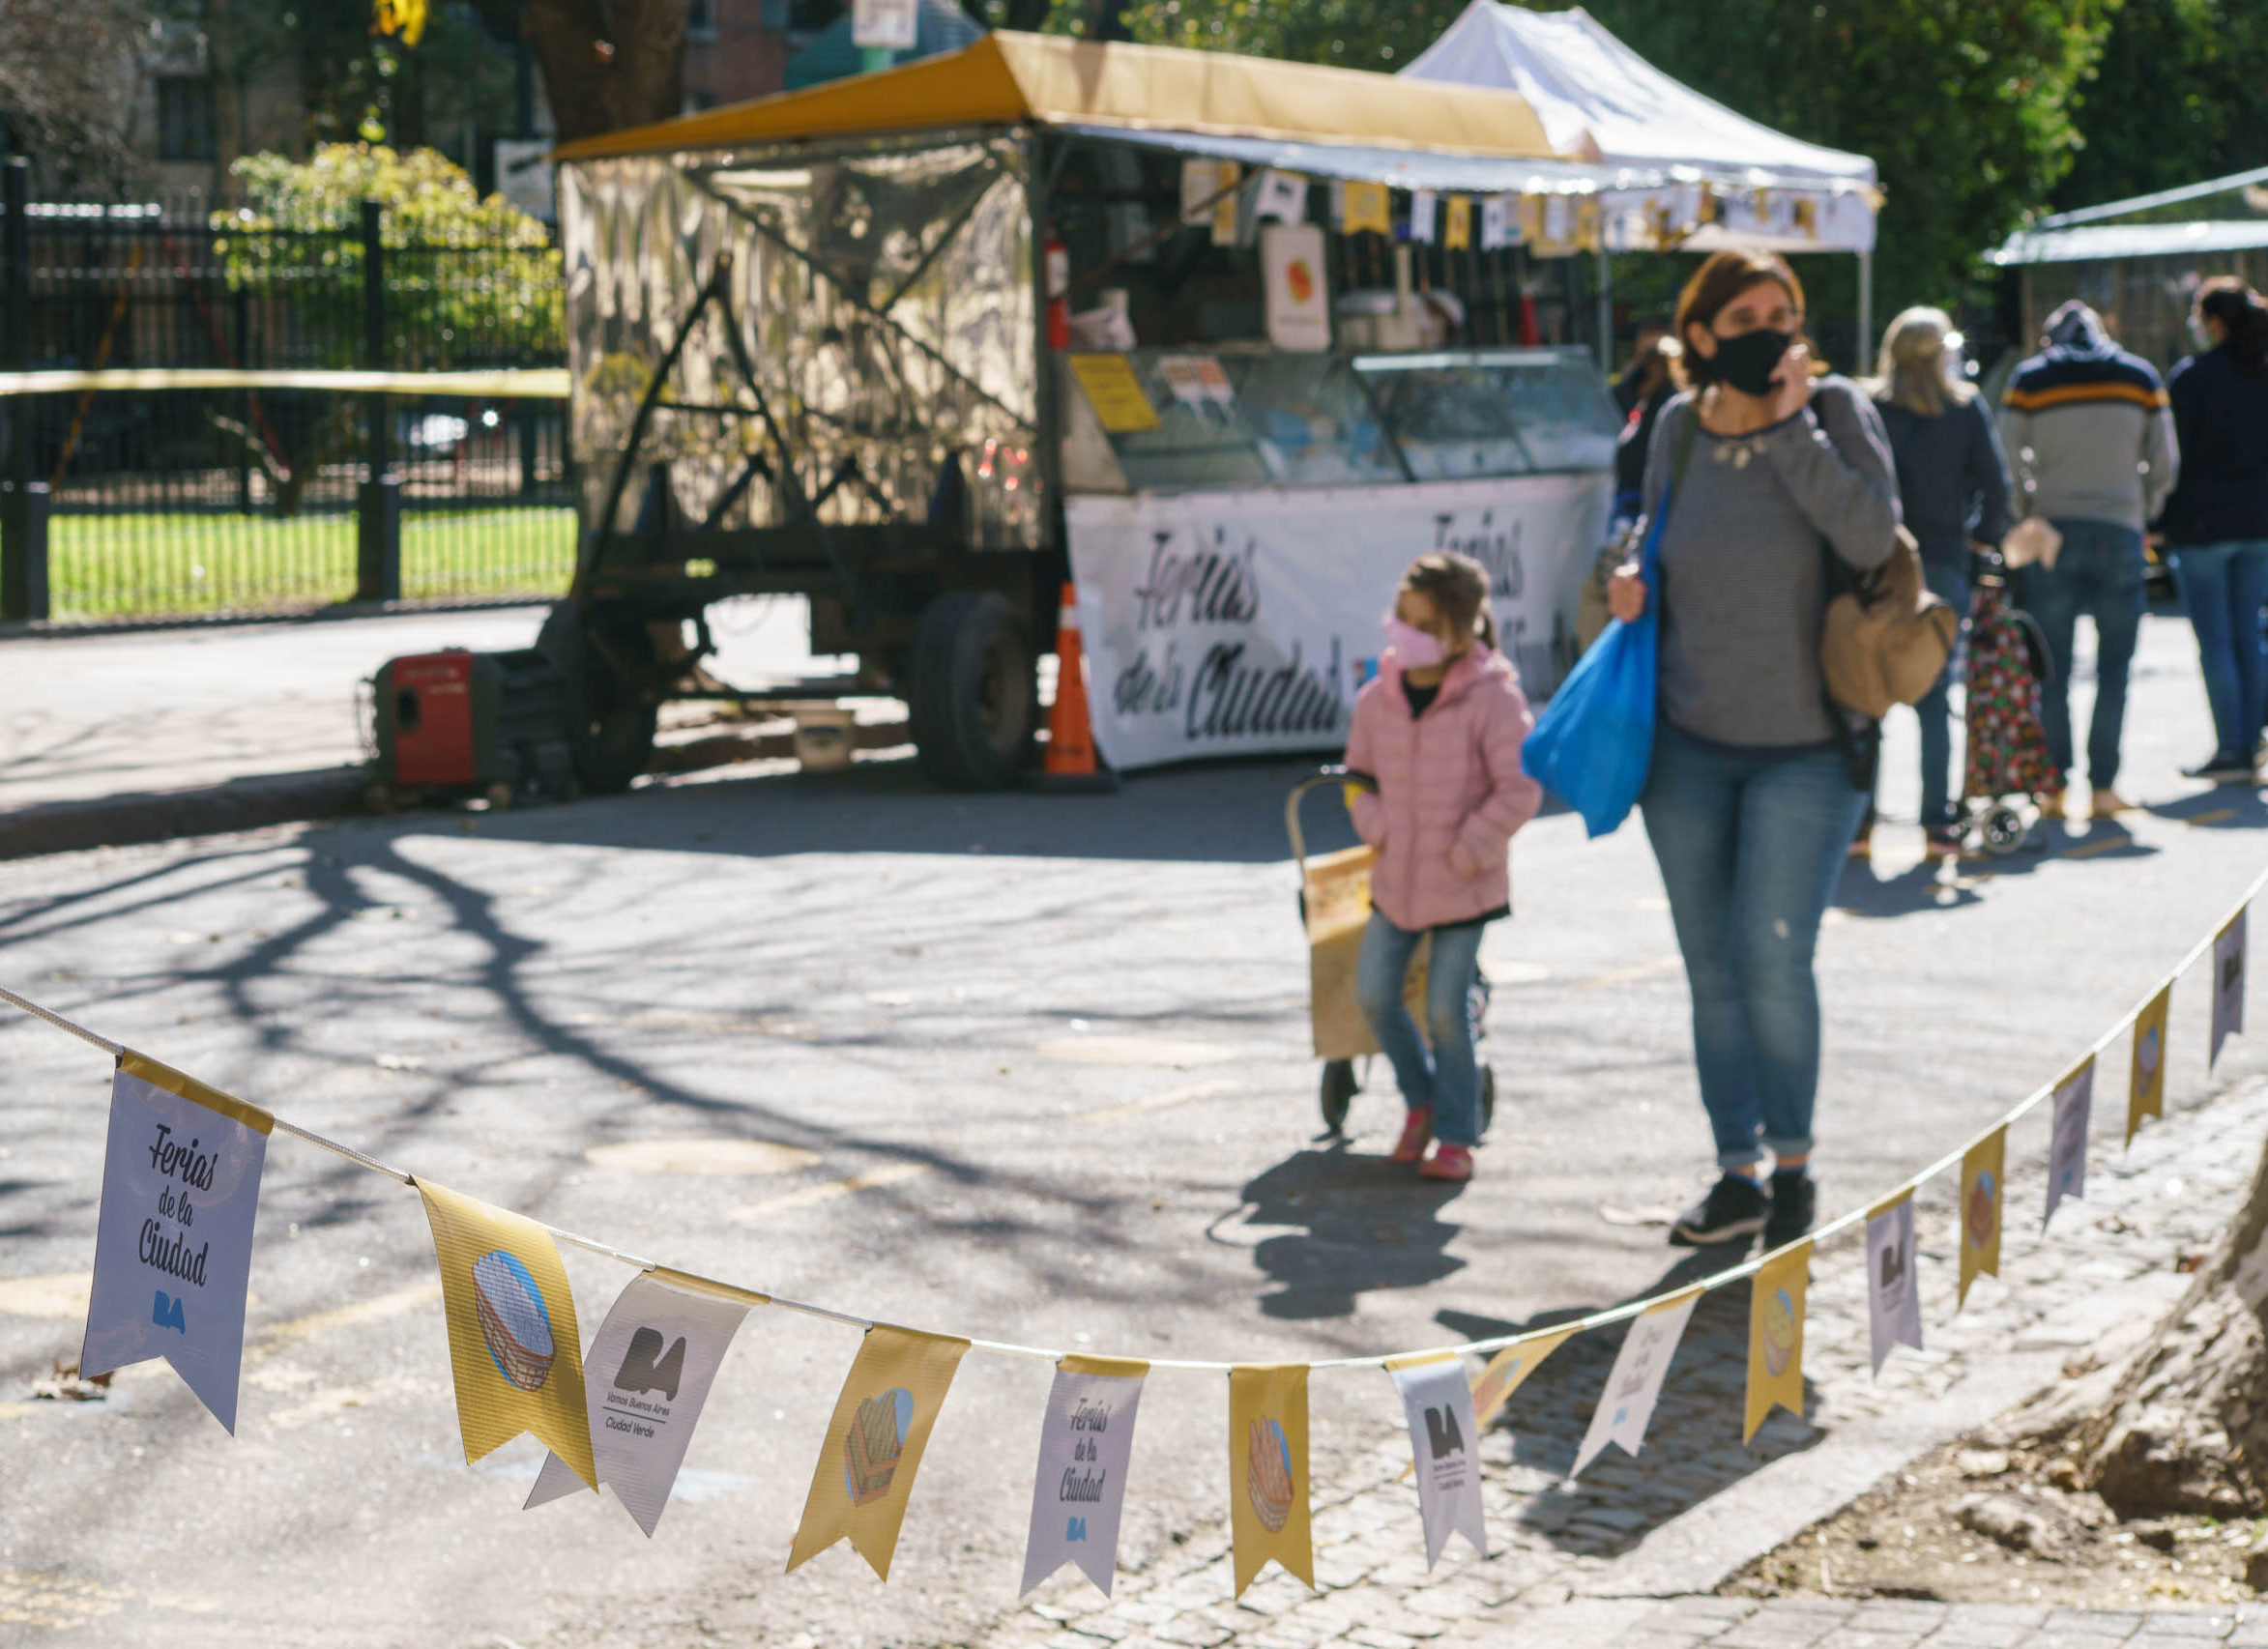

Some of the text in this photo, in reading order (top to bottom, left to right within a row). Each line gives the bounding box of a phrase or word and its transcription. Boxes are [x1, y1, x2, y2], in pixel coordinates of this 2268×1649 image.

[1134, 522, 1257, 630] Ferias
[1185, 636, 1341, 740] Ciudad
[149, 1123, 218, 1192] Ferias
[159, 1185, 193, 1227] de la
[138, 1217, 209, 1287] Ciudad
[152, 1289, 186, 1335] BA
[614, 1326, 686, 1402] BA
[607, 1391, 671, 1417] Vamos Buenos Aires
[1070, 1398, 1112, 1432] Ferias
[605, 1416, 655, 1438] Ciudad Verde
[1074, 1437, 1097, 1462] de la
[1060, 1467, 1106, 1502] Ciudad
